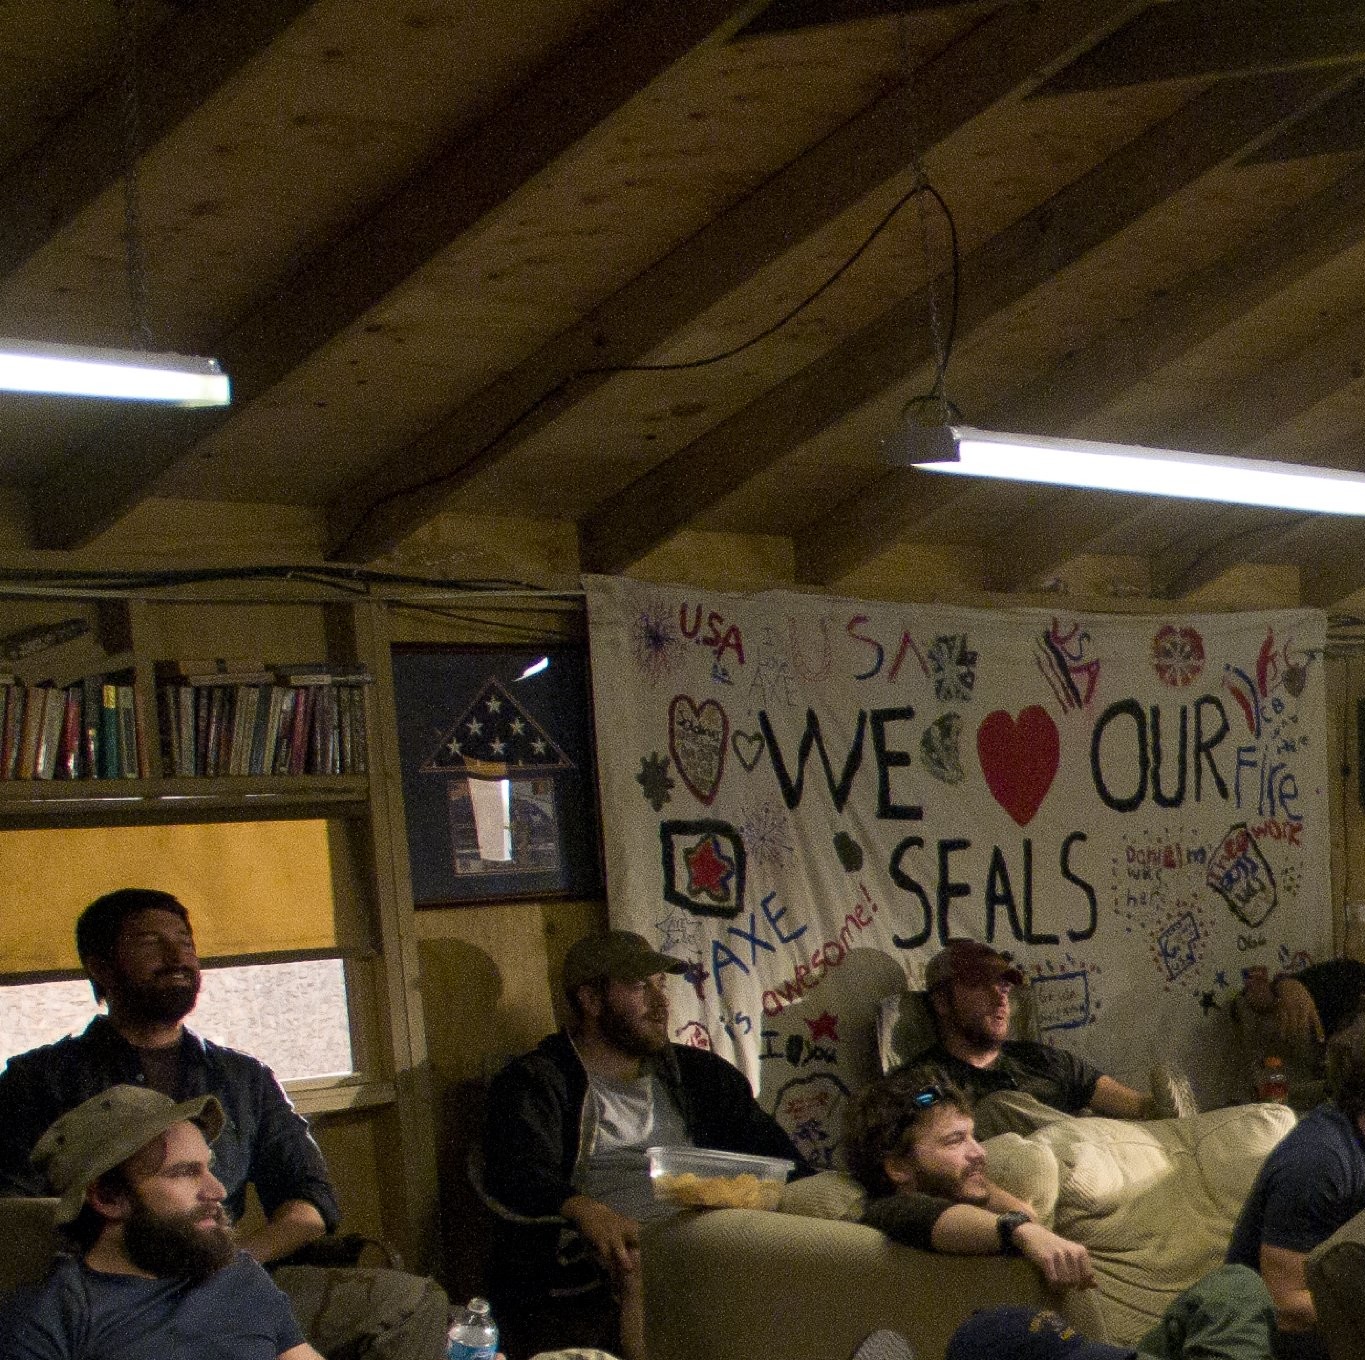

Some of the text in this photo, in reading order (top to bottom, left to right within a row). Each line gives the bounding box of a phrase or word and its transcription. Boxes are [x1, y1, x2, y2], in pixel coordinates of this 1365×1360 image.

[679, 602, 746, 665] USA
[785, 615, 931, 684] USA
[758, 705, 923, 821] WE
[1090, 694, 1231, 813] OUR
[1235, 745, 1304, 821] Fire
[889, 831, 1098, 949] SEALS
[711, 891, 808, 995] AXE
[719, 882, 878, 1041] is awesome!
